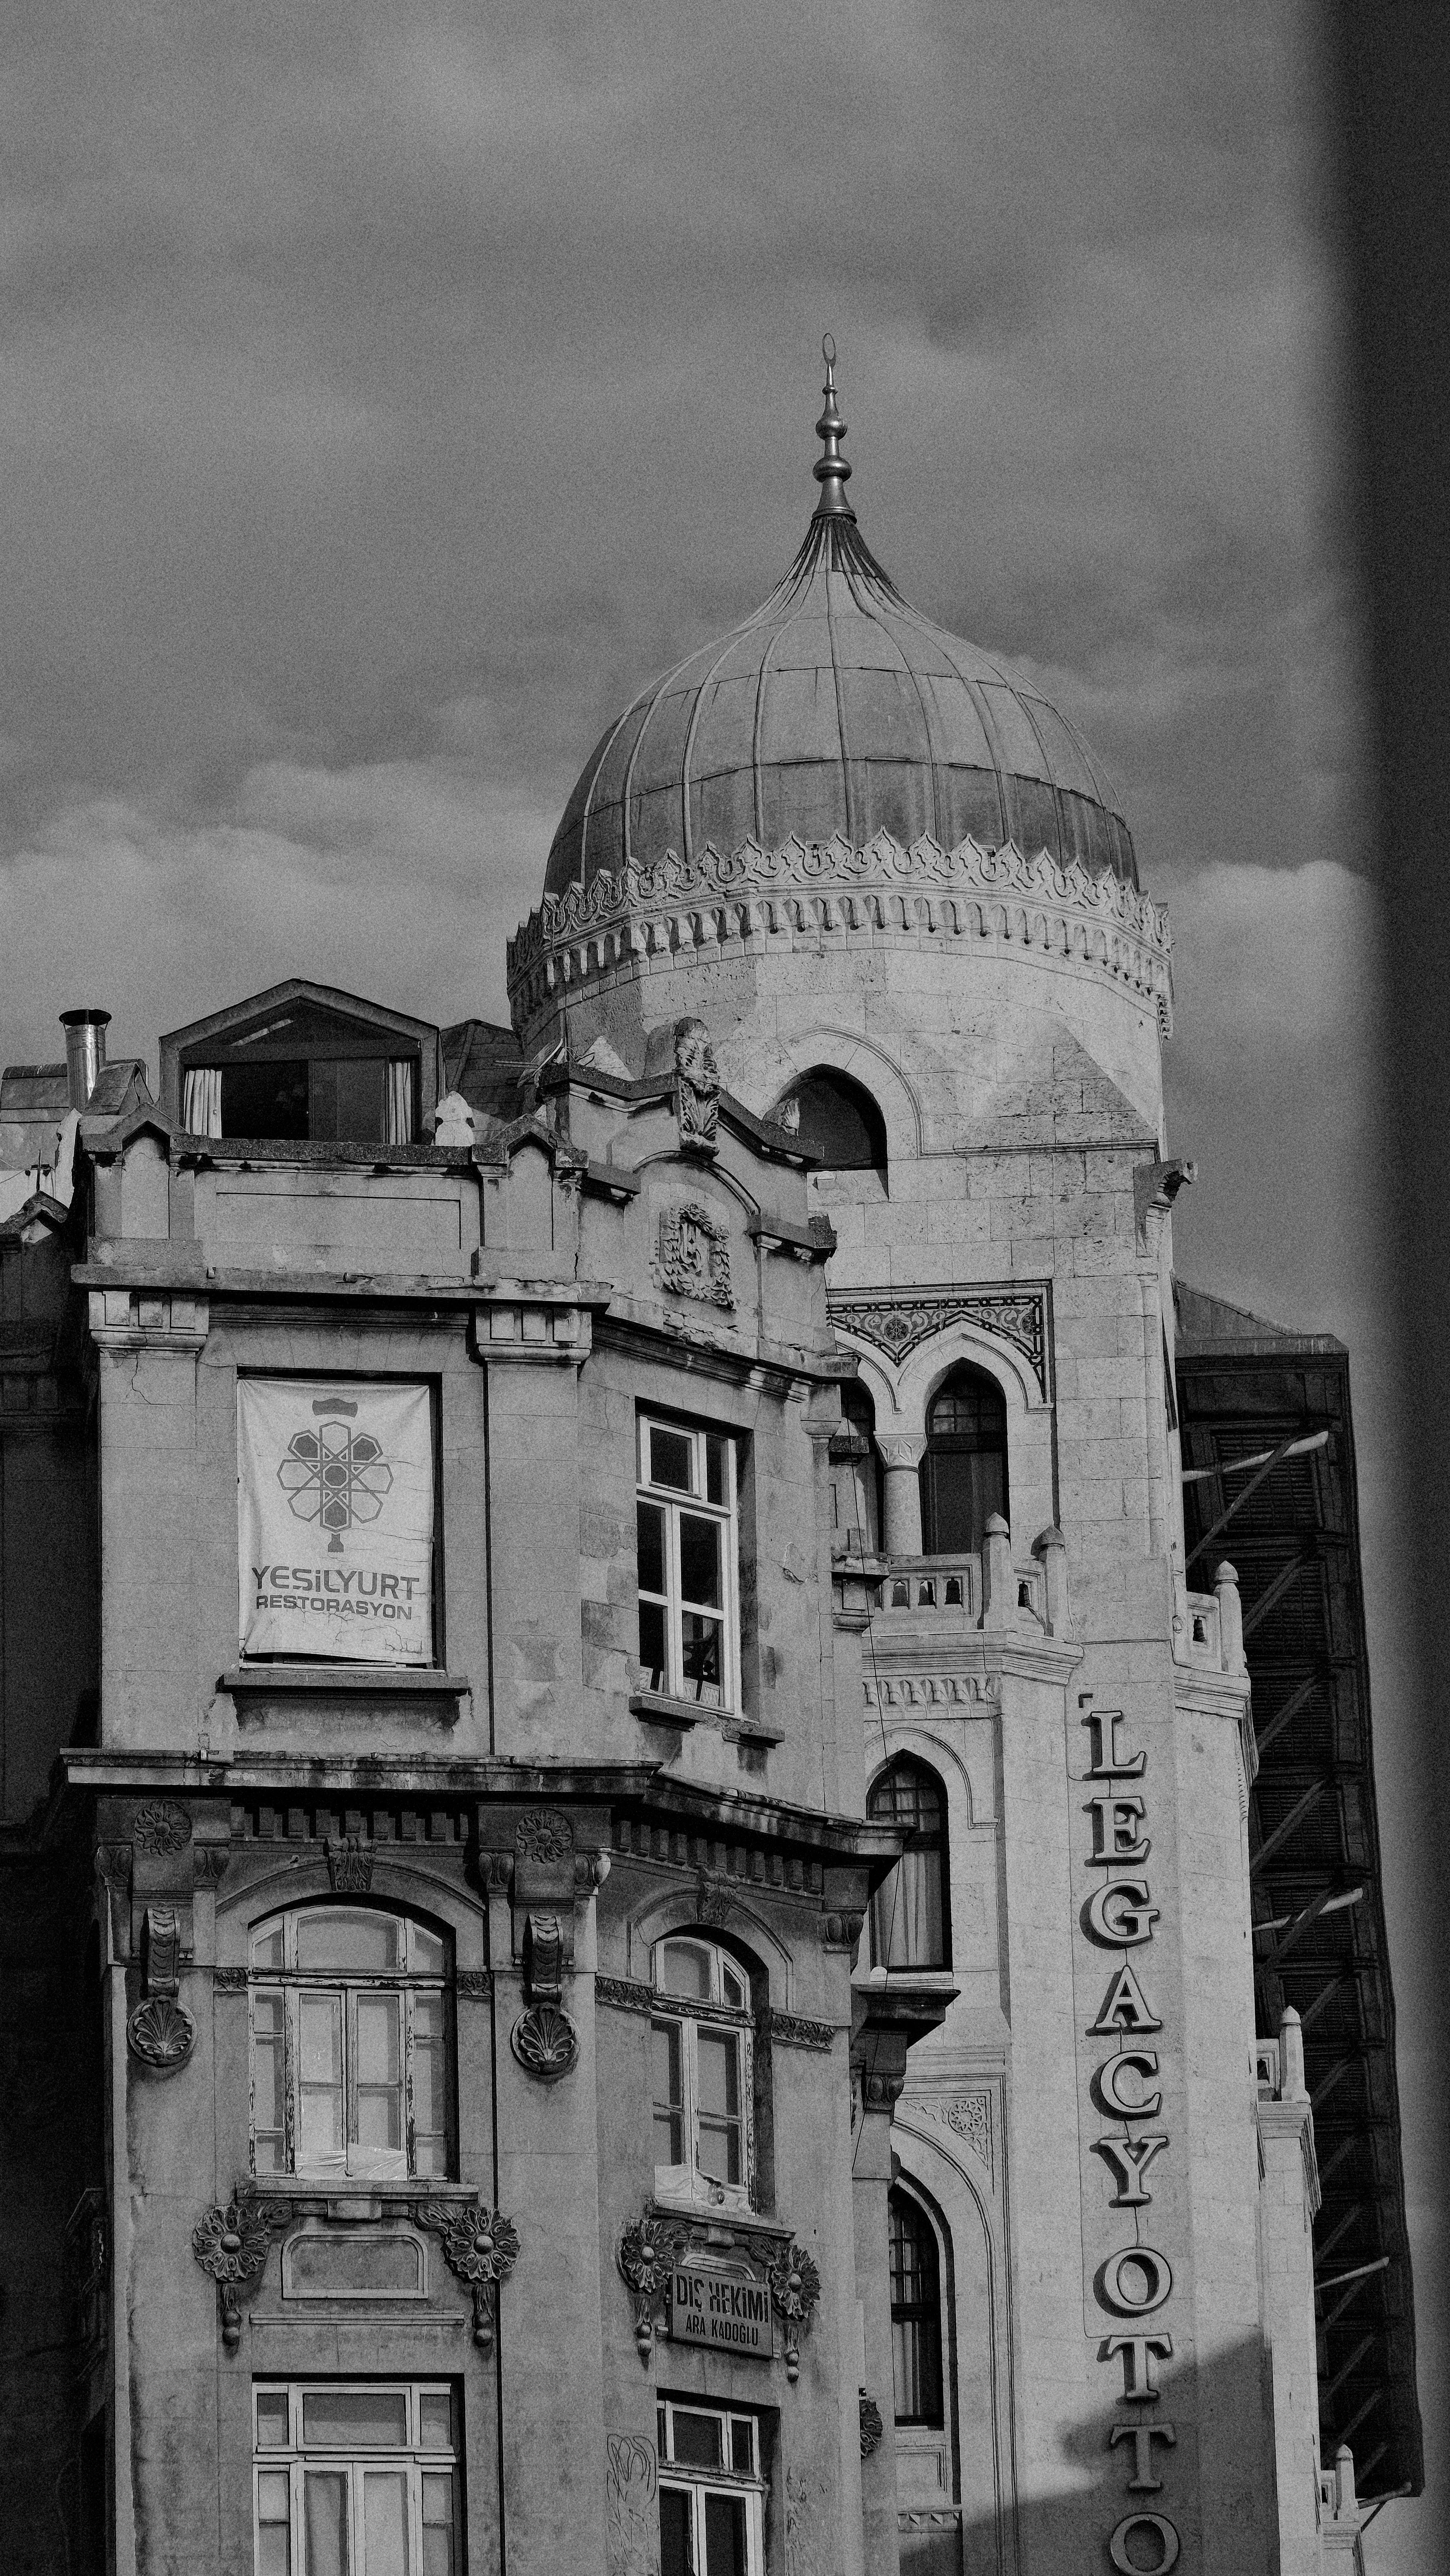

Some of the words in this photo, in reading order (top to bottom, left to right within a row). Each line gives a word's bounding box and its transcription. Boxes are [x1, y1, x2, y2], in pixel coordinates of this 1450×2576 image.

[256, 1595, 412, 1619] RESTORASYON
[1089, 1710, 1169, 2204] LEGACY
[685, 2314, 706, 2336] ARA
[711, 2318, 758, 2346] KADOĞLU
[1104, 2247, 1180, 2576] OTTO
